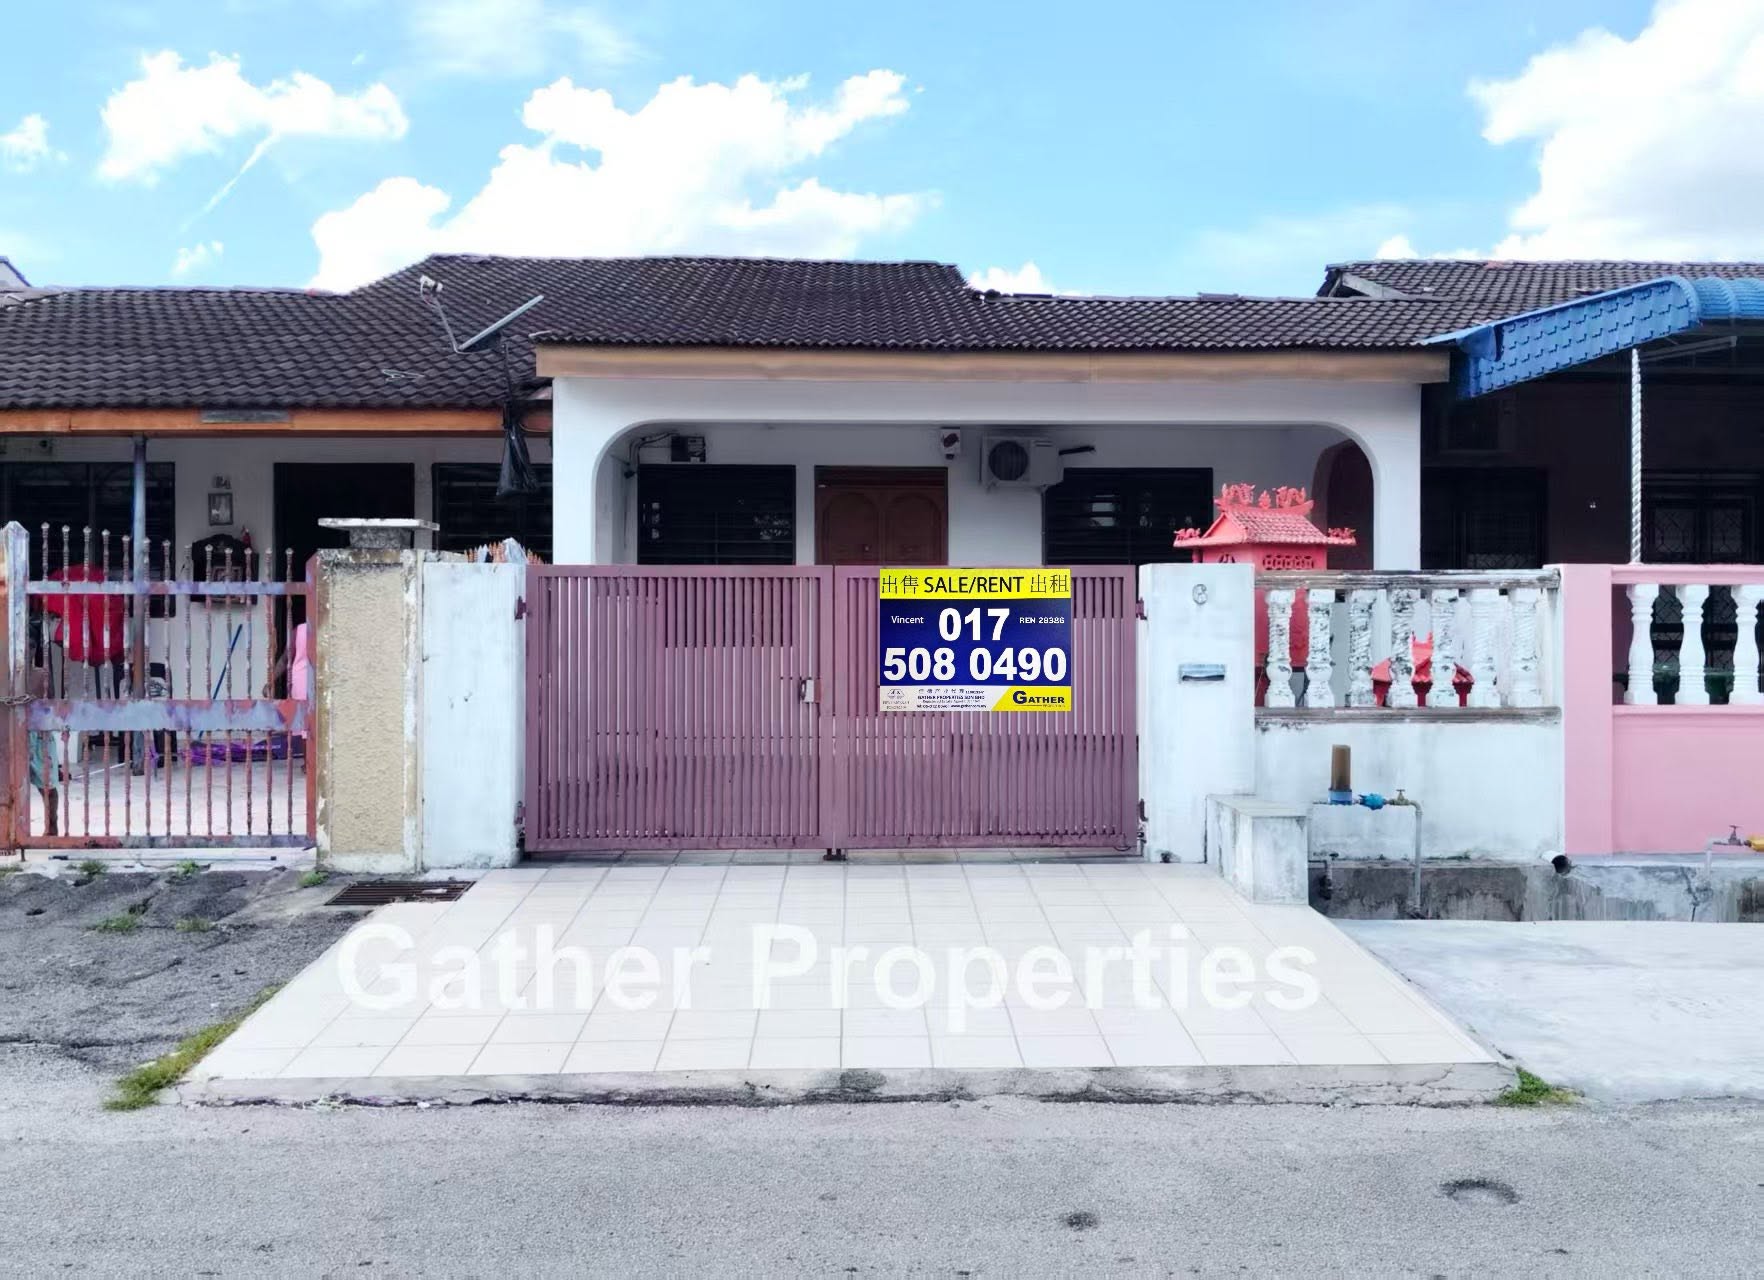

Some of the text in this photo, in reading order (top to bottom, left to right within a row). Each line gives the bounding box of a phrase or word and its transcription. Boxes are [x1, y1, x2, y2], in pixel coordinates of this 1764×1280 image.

[882, 574, 1069, 594] 出售 SALE/RENT 出租
[1192, 583, 1208, 605] 6
[891, 615, 924, 624] Vincent
[939, 607, 1010, 641] 017
[1019, 616, 1036, 624] REN
[883, 647, 1067, 681] 508 0490
